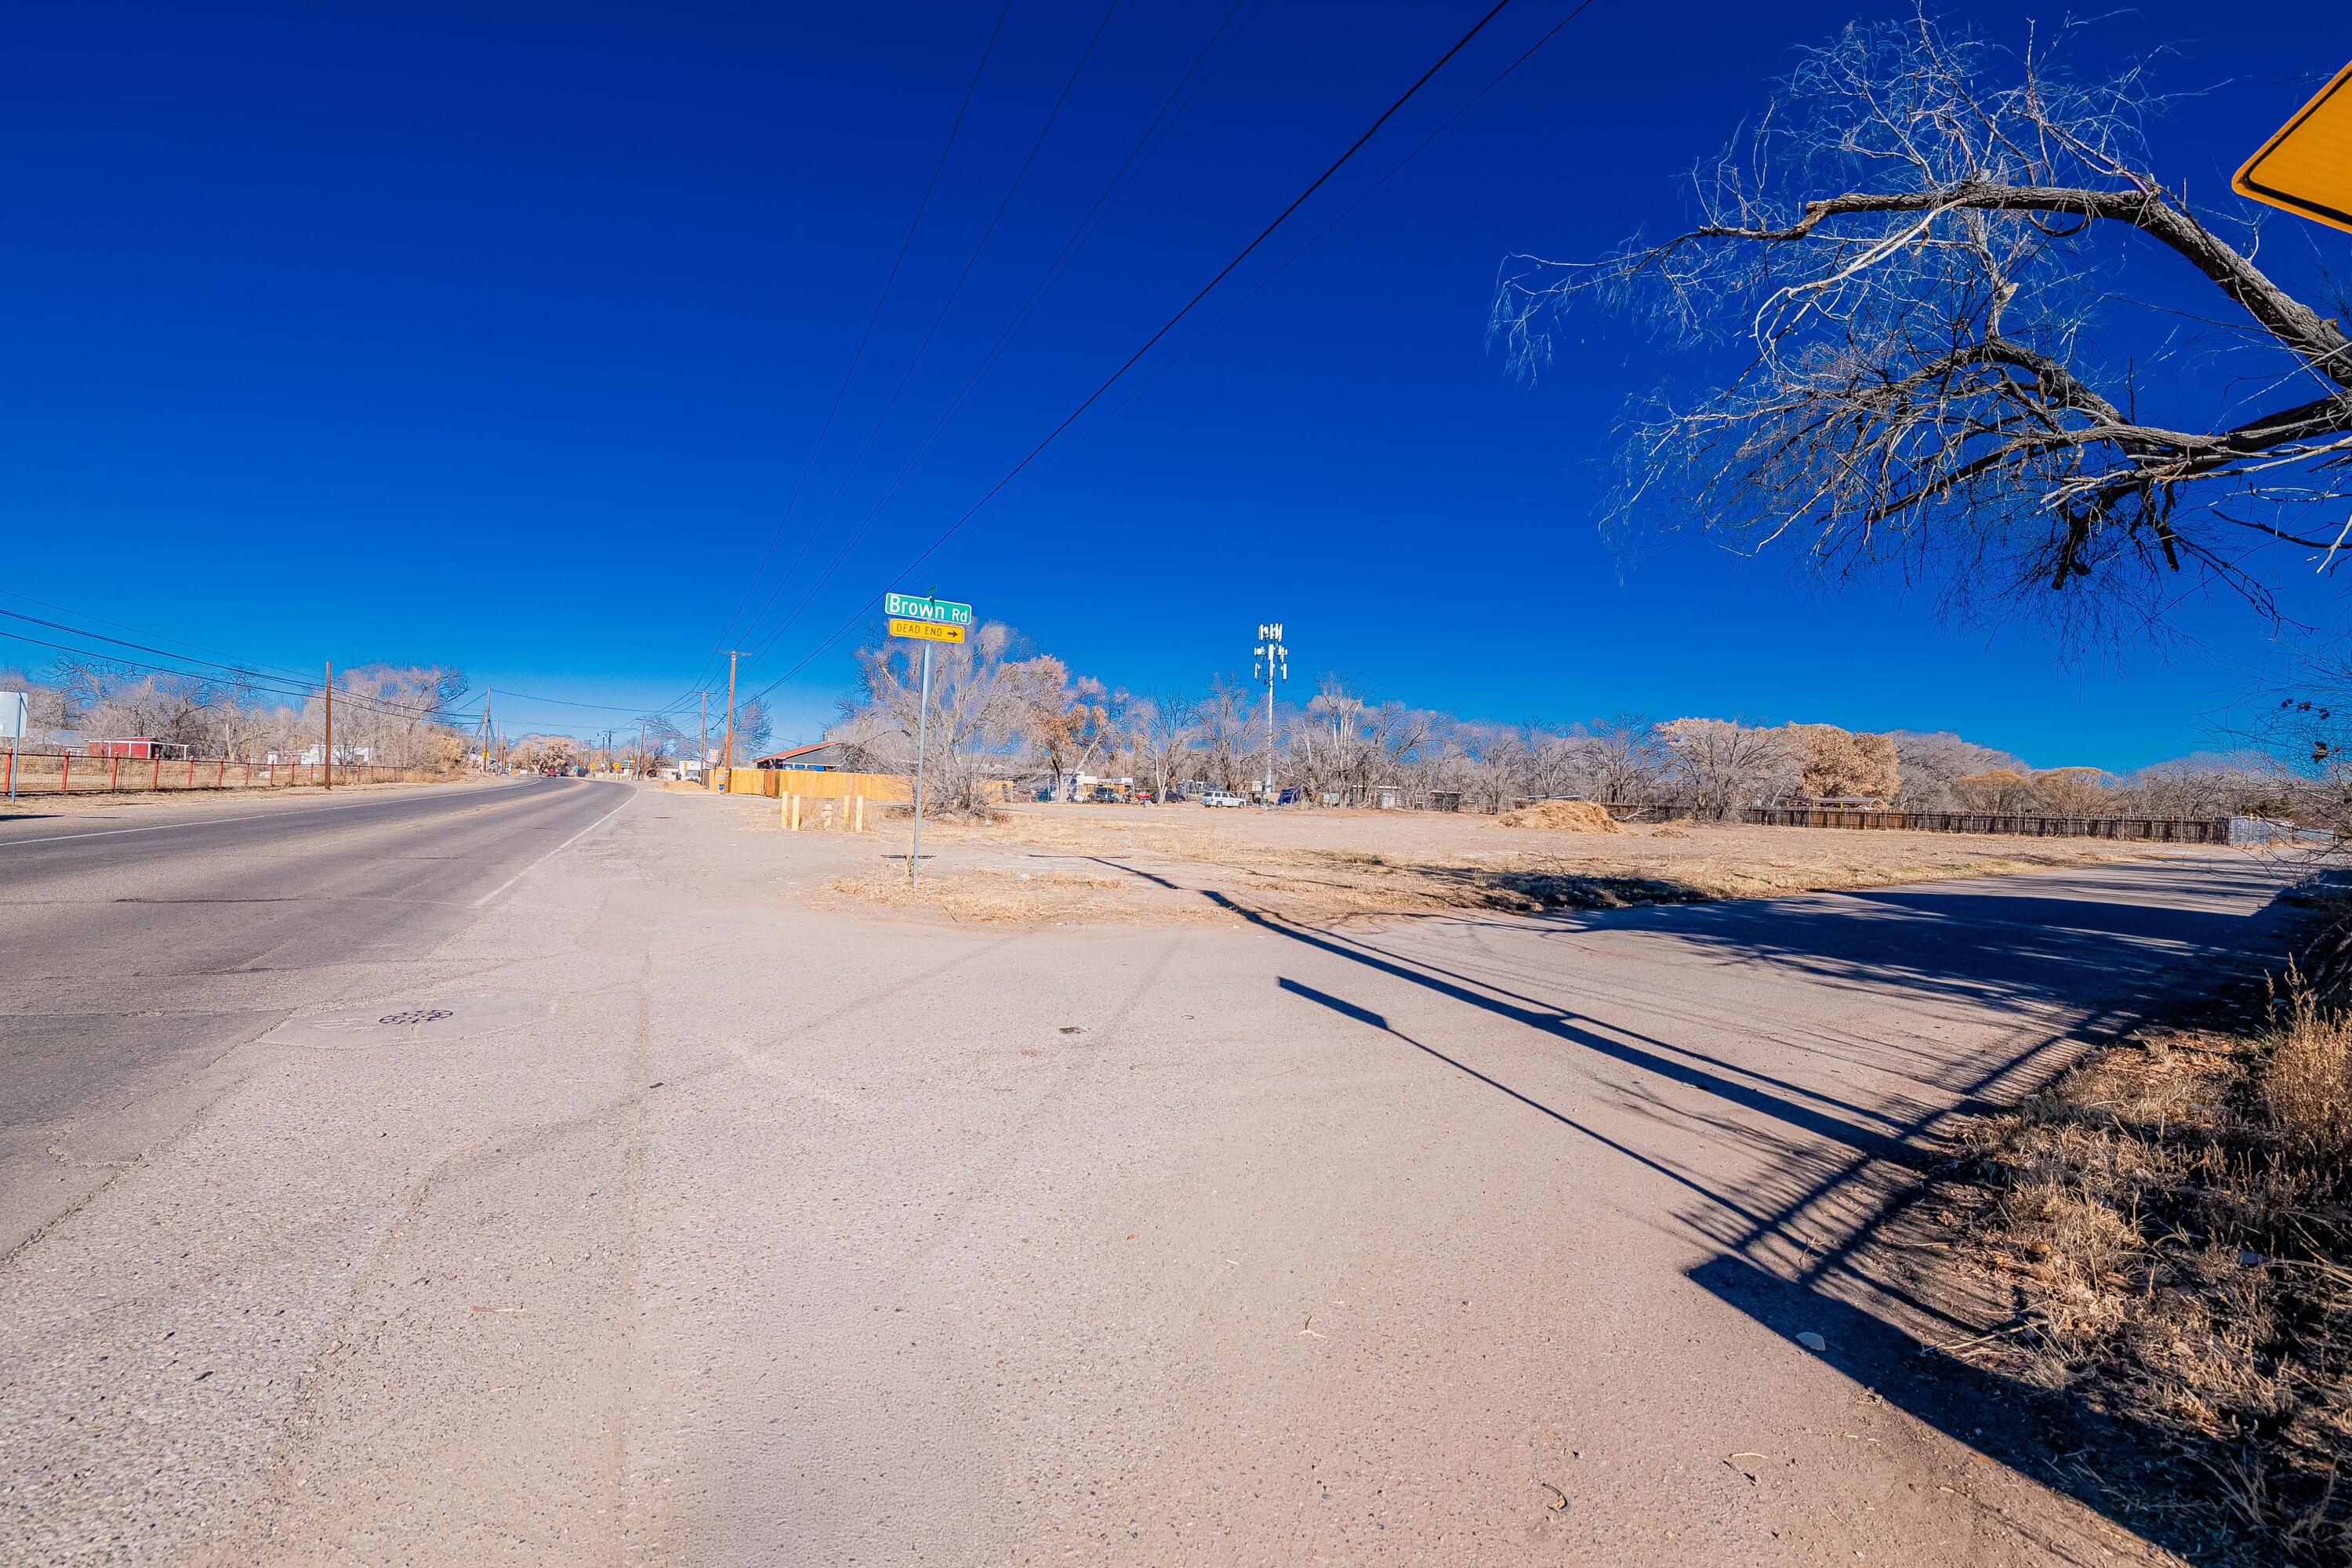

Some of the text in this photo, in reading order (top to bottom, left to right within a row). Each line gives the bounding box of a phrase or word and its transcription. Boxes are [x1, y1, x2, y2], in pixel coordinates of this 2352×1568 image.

[889, 595, 968, 622] Brown Rd
[896, 622, 942, 637] DEAD END
